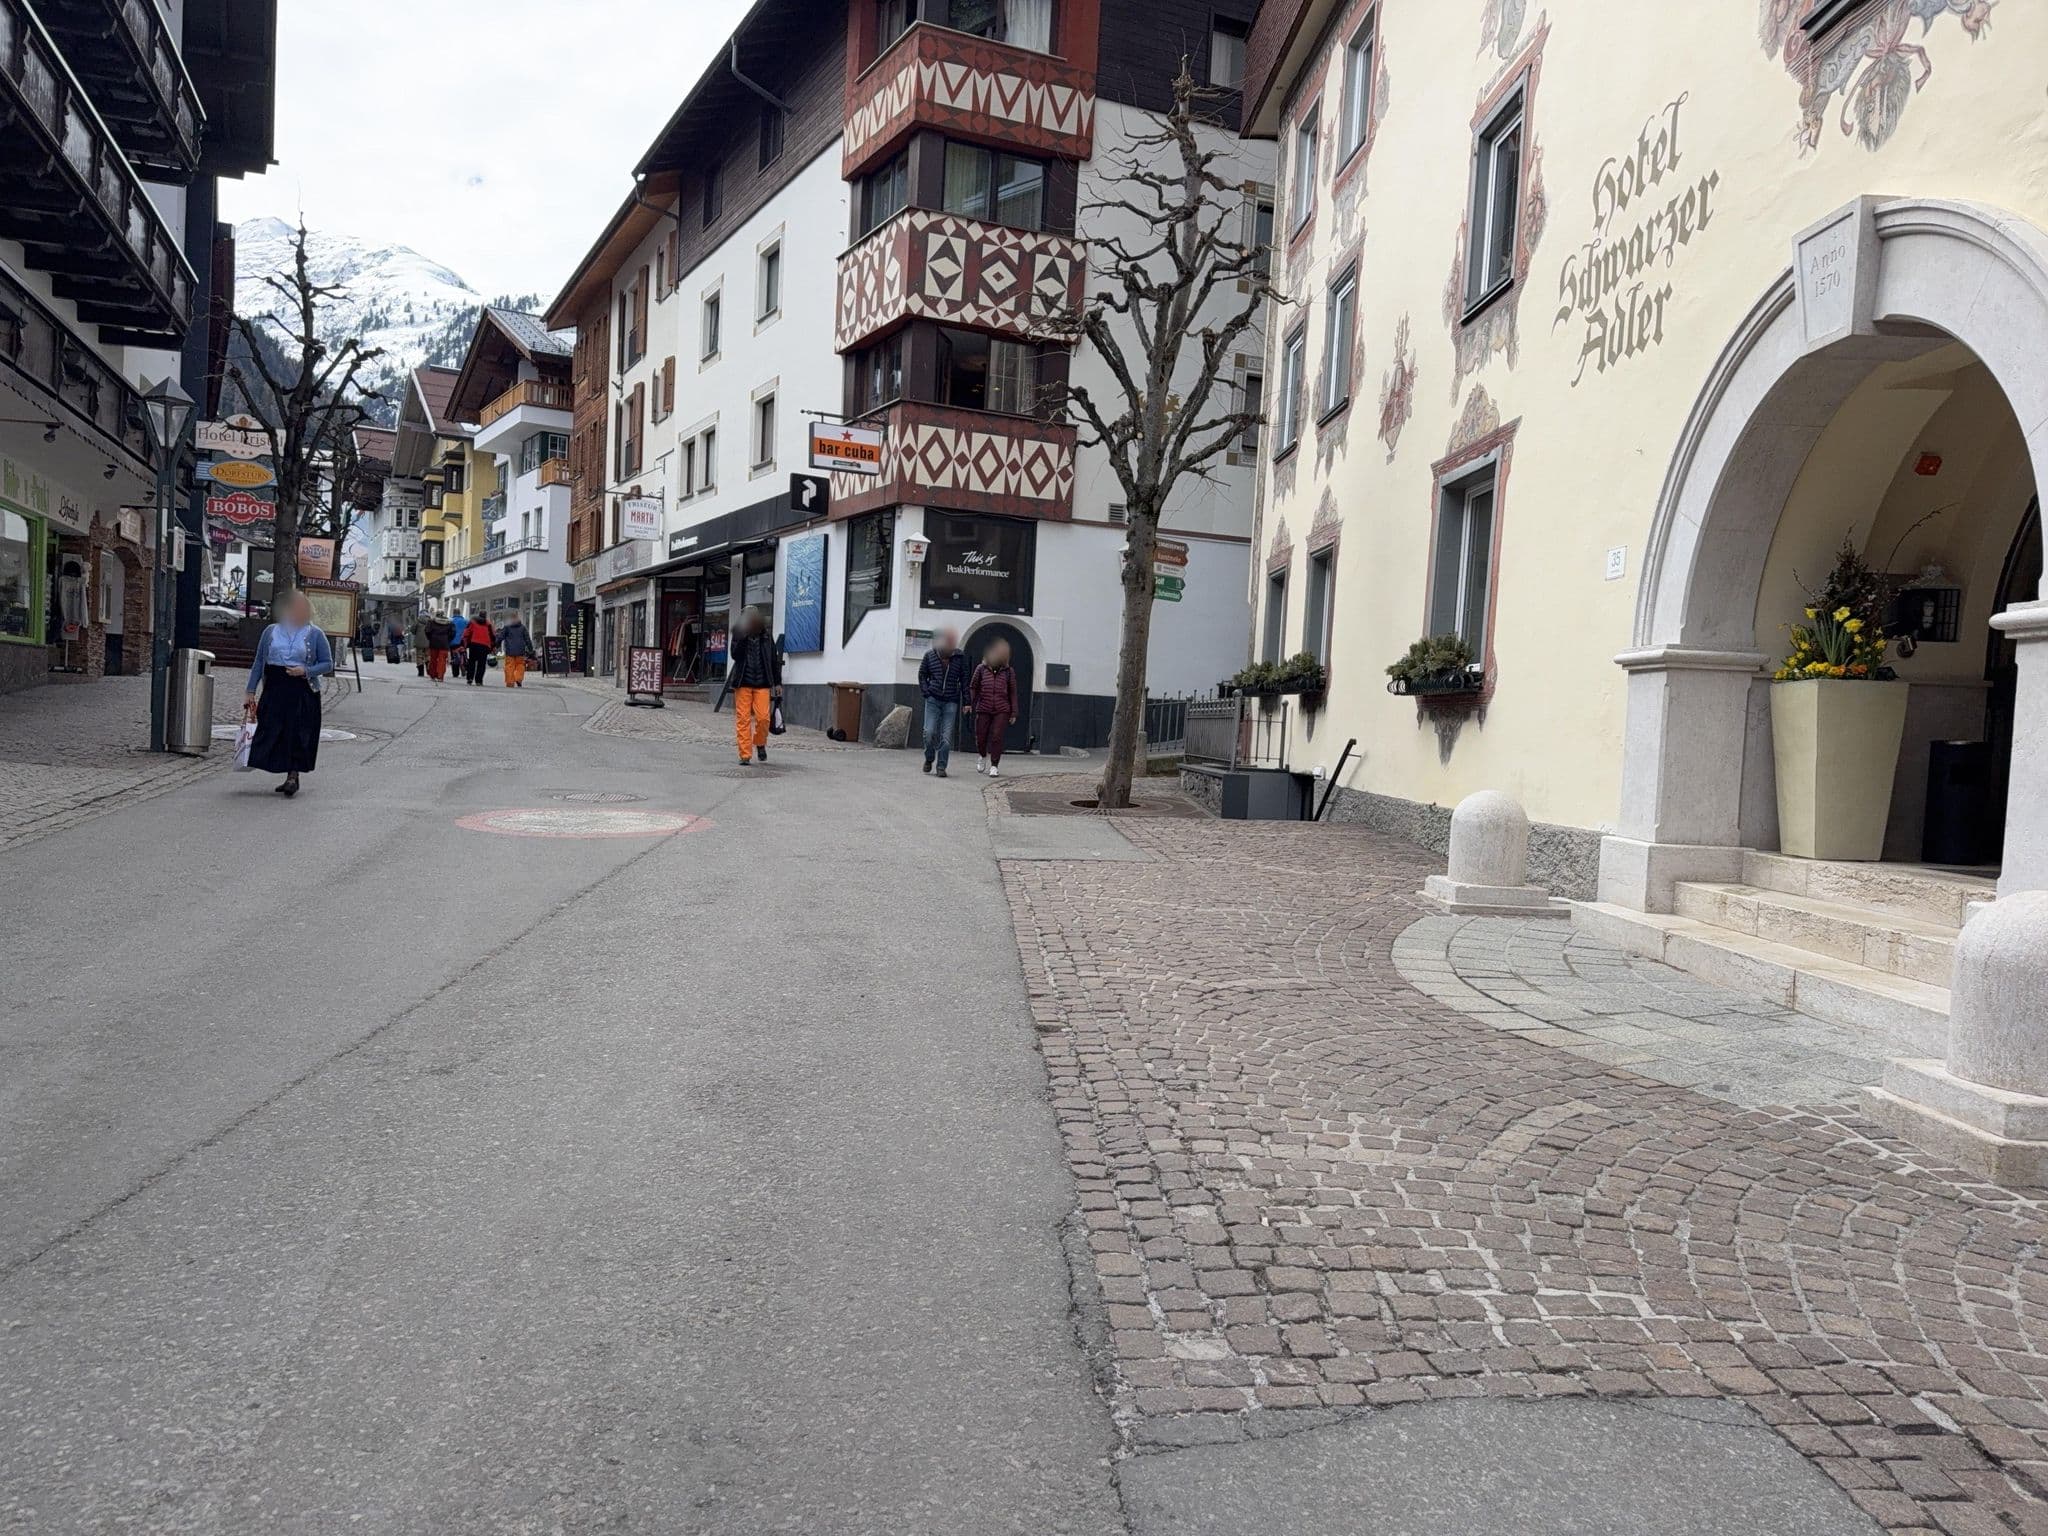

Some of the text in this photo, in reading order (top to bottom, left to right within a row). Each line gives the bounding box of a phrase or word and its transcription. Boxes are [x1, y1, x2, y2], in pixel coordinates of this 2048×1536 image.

[1592, 90, 1688, 237] Hotel
[1551, 169, 1719, 336] Schwarzer
[1811, 245, 1845, 274] Anno
[1815, 270, 1840, 297] 1570
[1570, 281, 1672, 387] Adler
[198, 427, 235, 442] Hotel
[819, 440, 874, 460] bar cuba
[213, 501, 270, 516] BOBOS
[630, 510, 654, 525] MARTH
[962, 551, 998, 566] This is
[1611, 551, 1621, 567] 35
[946, 564, 1010, 578] PeakPerformance
[307, 579, 357, 589] RESTAURANT
[569, 623, 577, 662] weinbar
[633, 651, 661, 662] SALE
[632, 661, 661, 672] SALE
[632, 671, 660, 682] SALE
[631, 681, 660, 691] SALE
